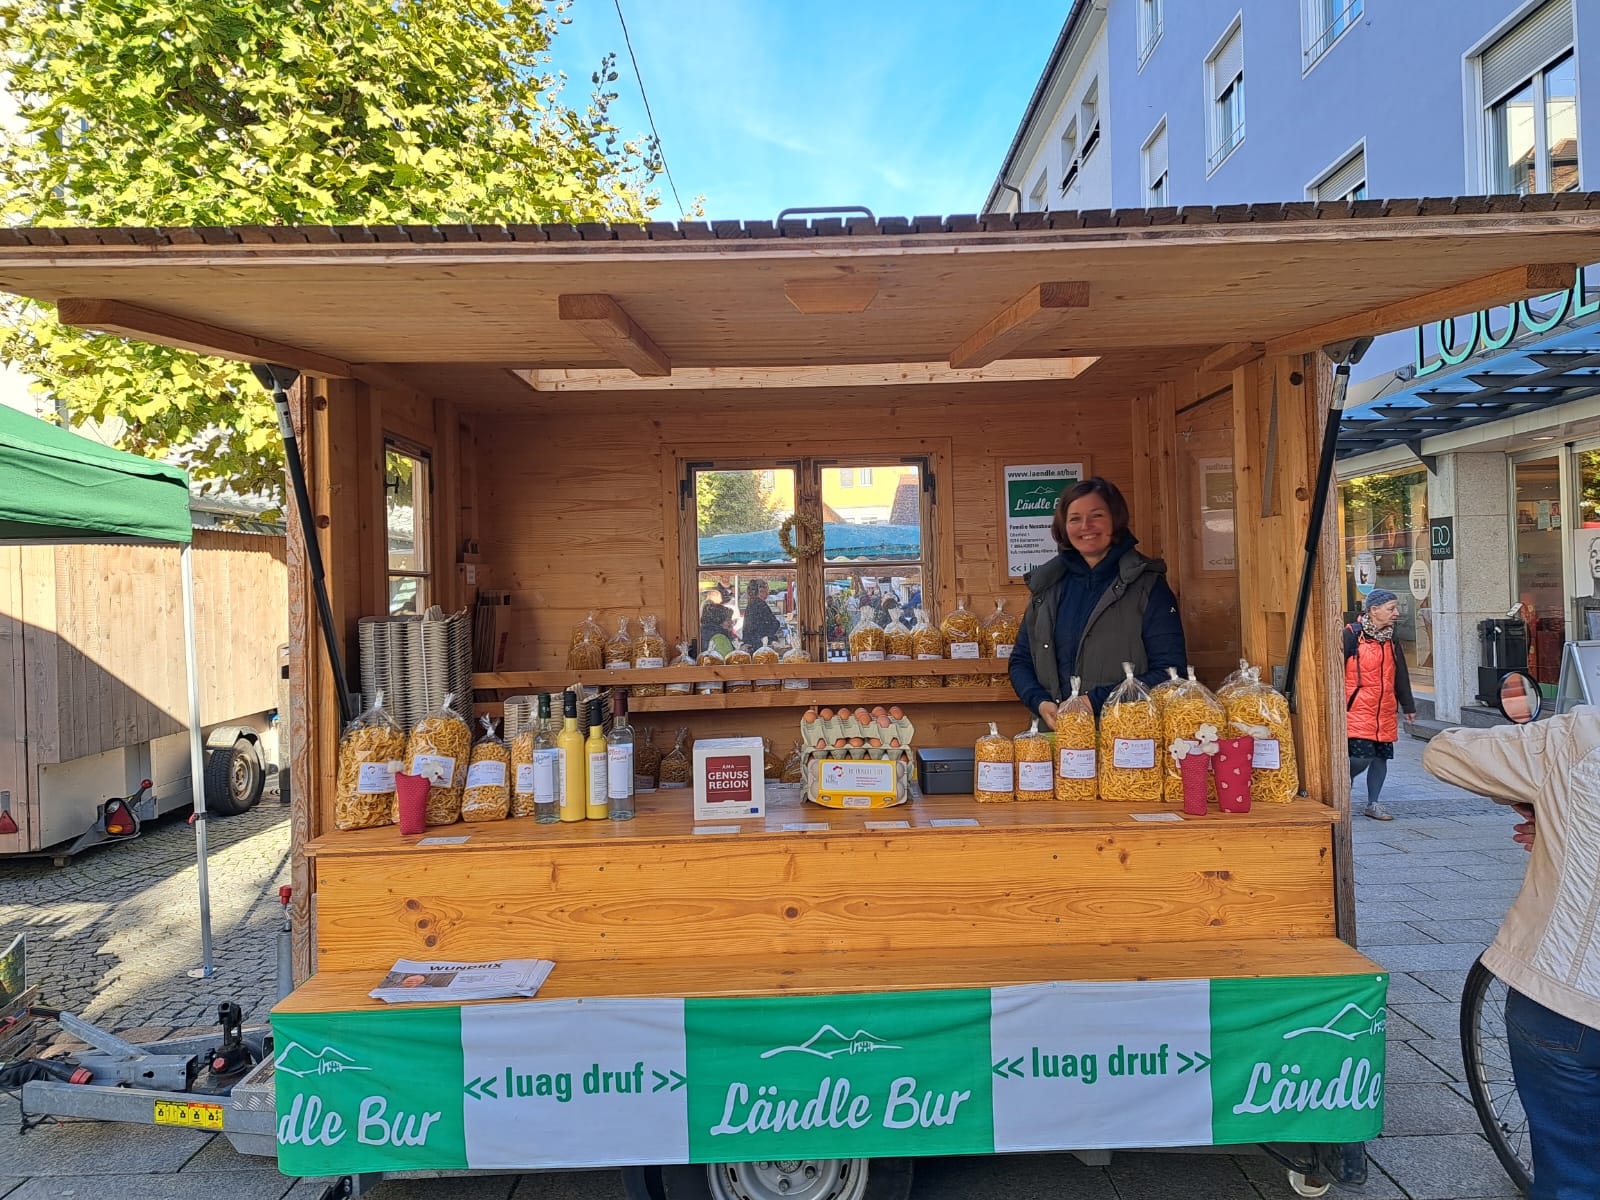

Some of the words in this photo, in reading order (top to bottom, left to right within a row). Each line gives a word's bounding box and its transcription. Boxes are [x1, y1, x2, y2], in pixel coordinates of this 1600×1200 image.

[1014, 497, 1051, 511] Ländle
[708, 770, 749, 780] GENUSS
[708, 780, 749, 790] REGION
[505, 1066, 573, 1104] luag
[582, 1061, 645, 1096] druf
[1032, 1046, 1098, 1085] luag
[1107, 1043, 1168, 1077] druf
[710, 1077, 871, 1136] Ländle
[883, 1077, 970, 1129] Bur
[1232, 1057, 1382, 1115] Ländle
[358, 1095, 441, 1147] Bur
